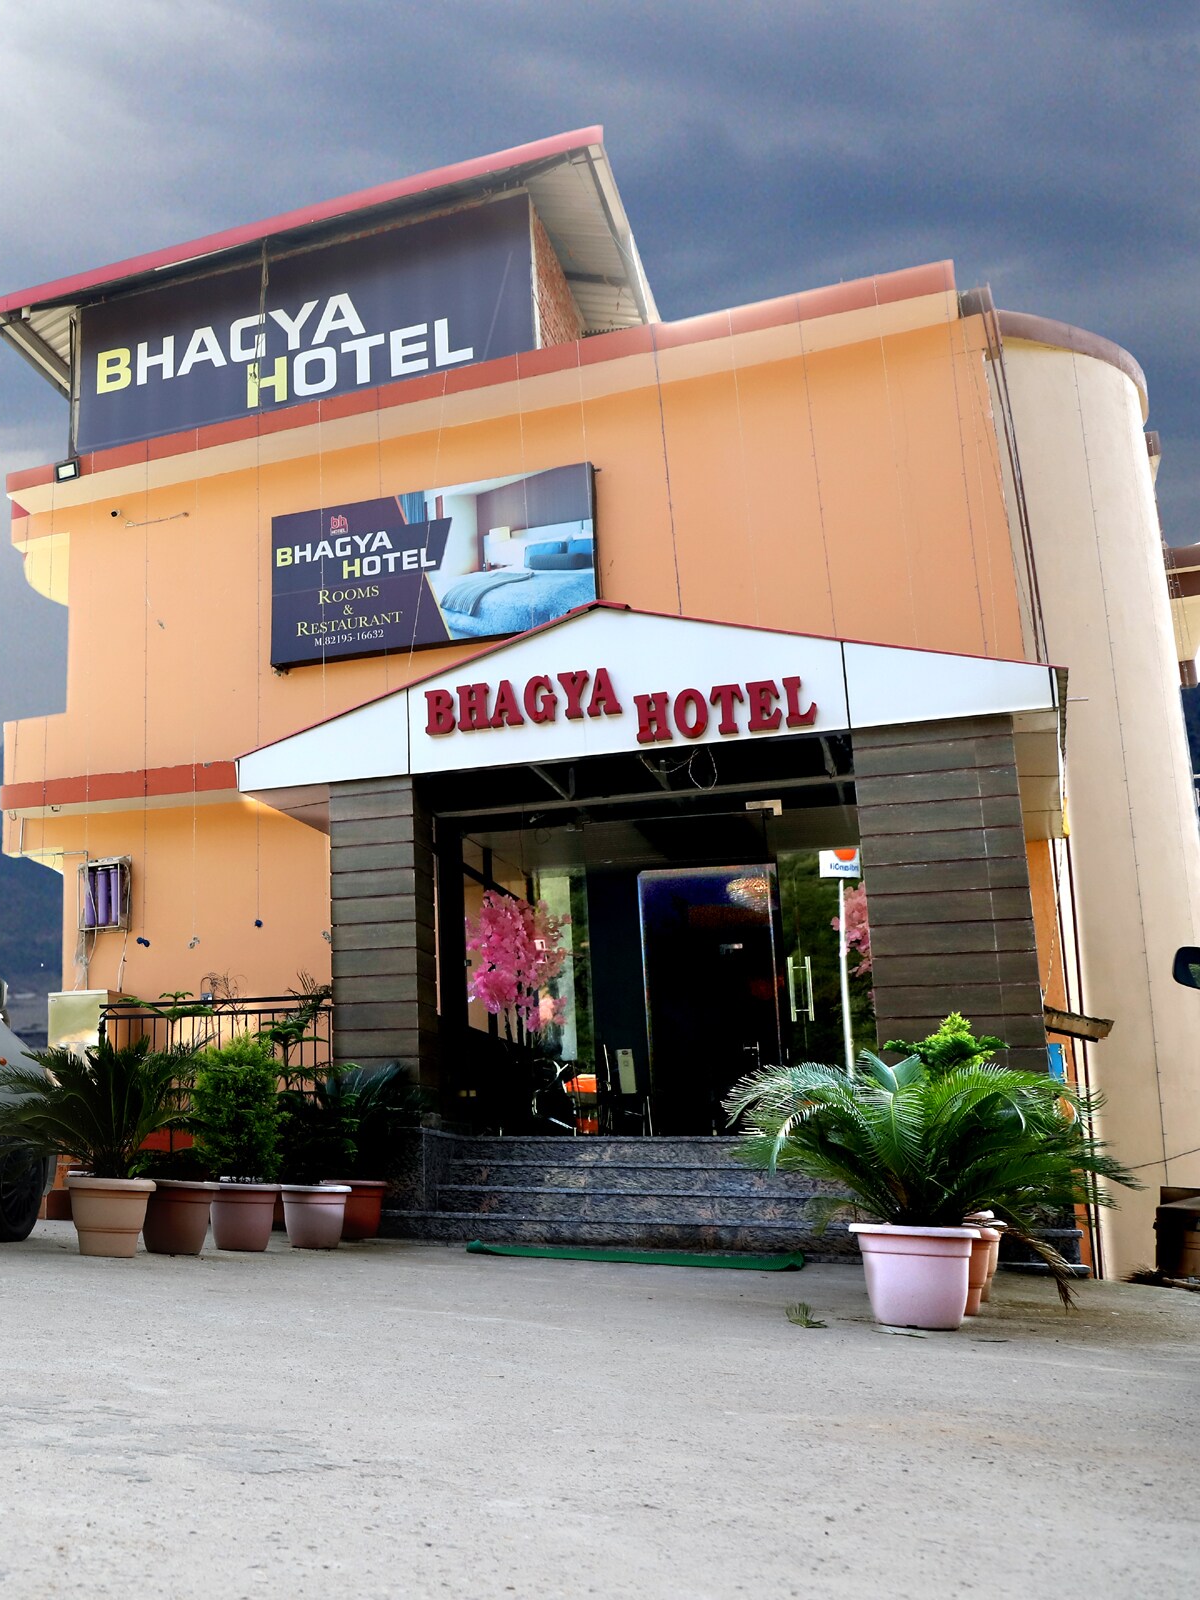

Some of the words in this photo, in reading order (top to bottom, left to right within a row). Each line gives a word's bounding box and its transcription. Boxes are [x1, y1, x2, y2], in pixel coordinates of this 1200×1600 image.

[96, 292, 366, 395] BHAGYA
[246, 317, 474, 409] HOTEL
[276, 530, 393, 567] BHAGYA
[342, 547, 437, 579] HOTEL
[318, 585, 380, 605] ROOMS
[343, 604, 354, 616] &
[296, 611, 403, 637] RESTAURANT
[424, 667, 623, 736] BHAGYA
[633, 675, 818, 744] HOTEL
